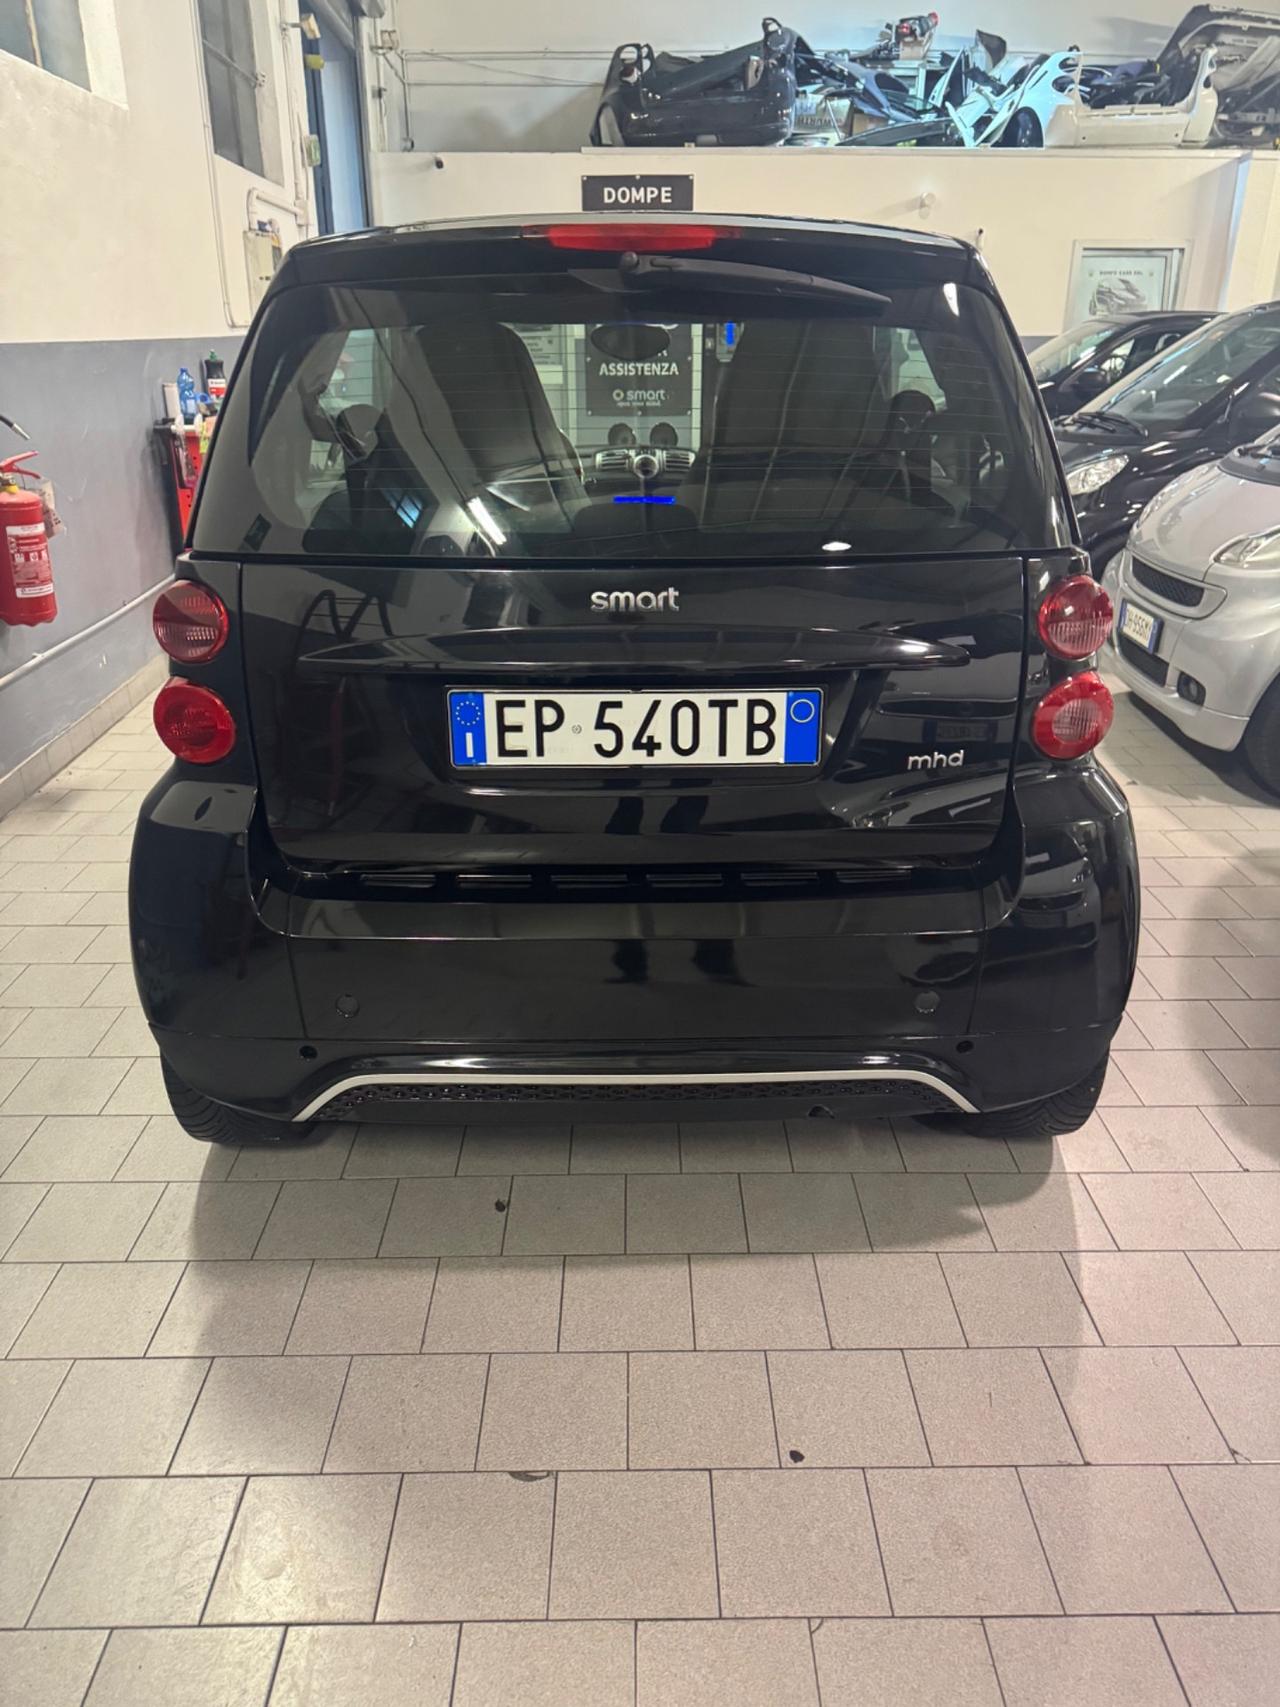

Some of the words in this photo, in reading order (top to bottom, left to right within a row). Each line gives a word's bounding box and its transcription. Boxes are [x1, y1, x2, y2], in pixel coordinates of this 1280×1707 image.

[603, 186, 673, 204] DOMPE
[599, 362, 679, 376] ASSISTENZA
[626, 389, 666, 401] smart
[590, 586, 680, 612] smart
[495, 699, 565, 758] EP
[593, 698, 777, 758] 540TB
[907, 749, 965, 770] mhd
